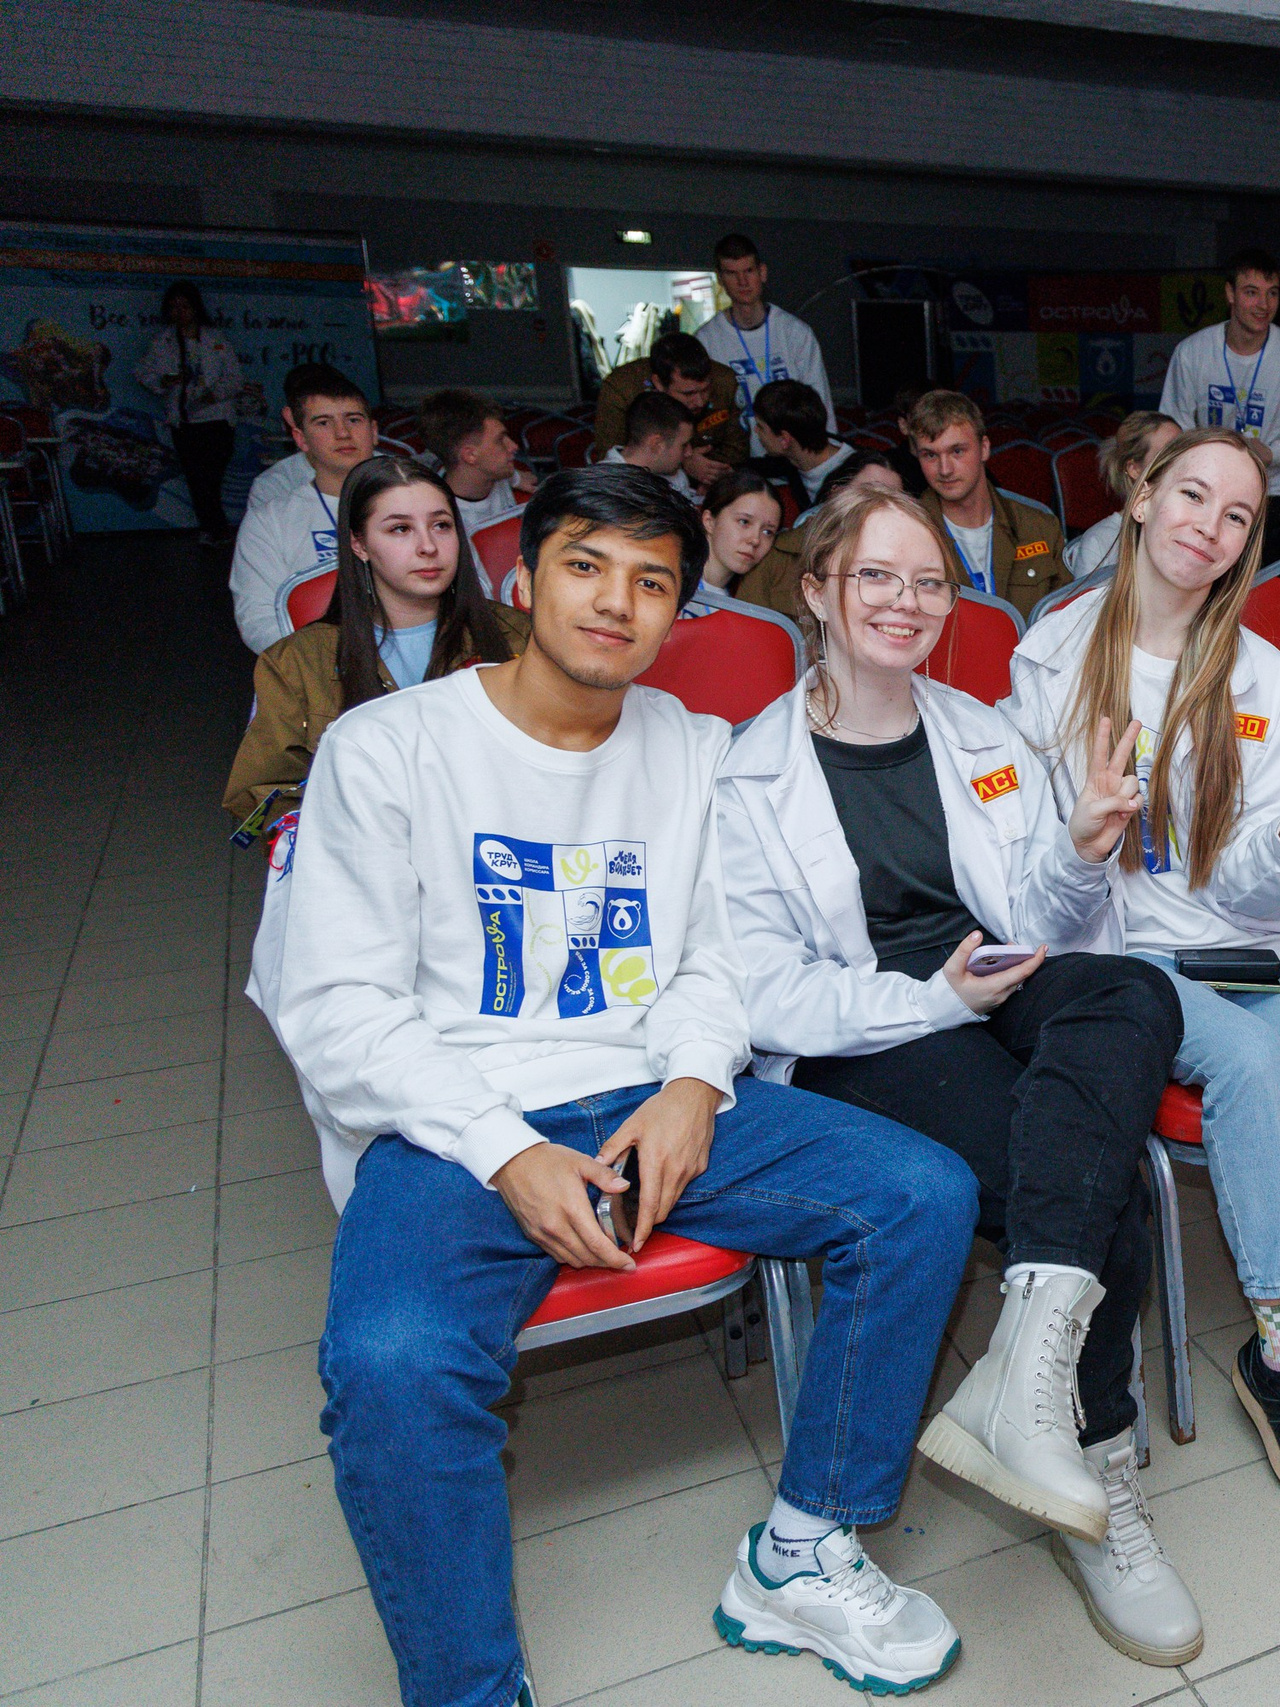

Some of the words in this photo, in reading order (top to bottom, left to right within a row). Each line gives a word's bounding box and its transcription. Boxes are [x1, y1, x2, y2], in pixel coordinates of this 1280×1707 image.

[487, 851, 513, 861] ТРУД
[491, 859, 518, 869] КРУТ
[772, 1542, 801, 1557] NIKE
